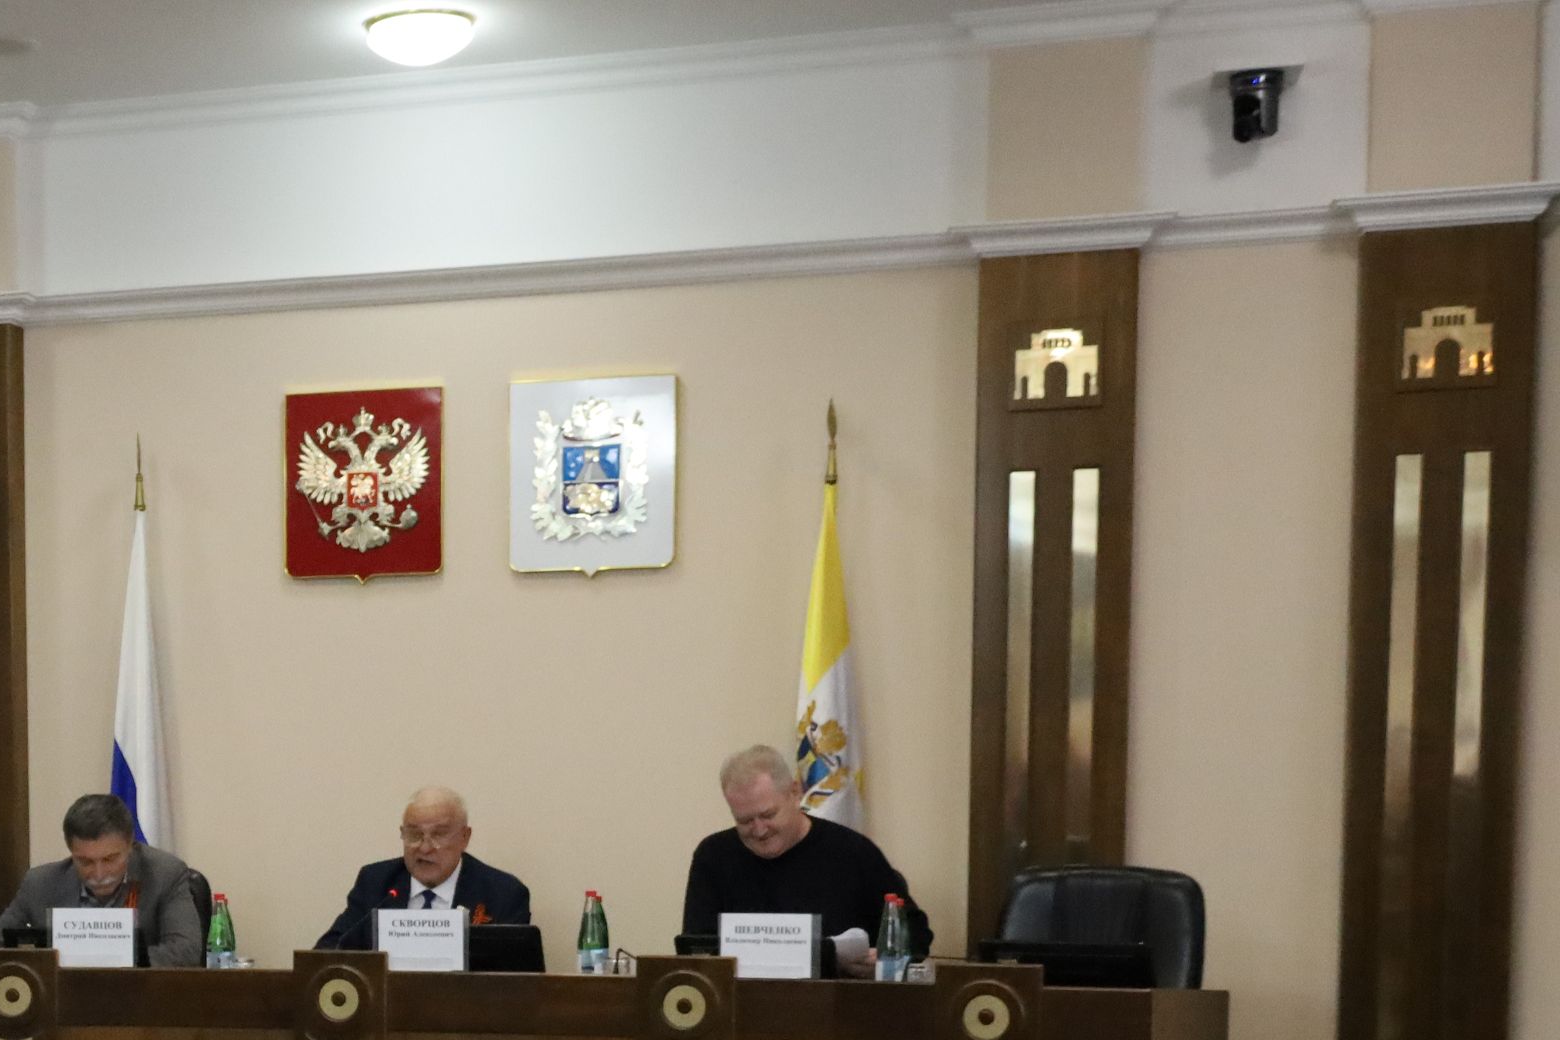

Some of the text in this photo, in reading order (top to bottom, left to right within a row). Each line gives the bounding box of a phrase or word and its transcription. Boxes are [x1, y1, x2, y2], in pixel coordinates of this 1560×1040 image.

[64, 921, 122, 930] СУДАВЦОВ
[391, 919, 450, 928] СКВОРЦОВ
[735, 926, 801, 935] ШЕВЧЕНКО
